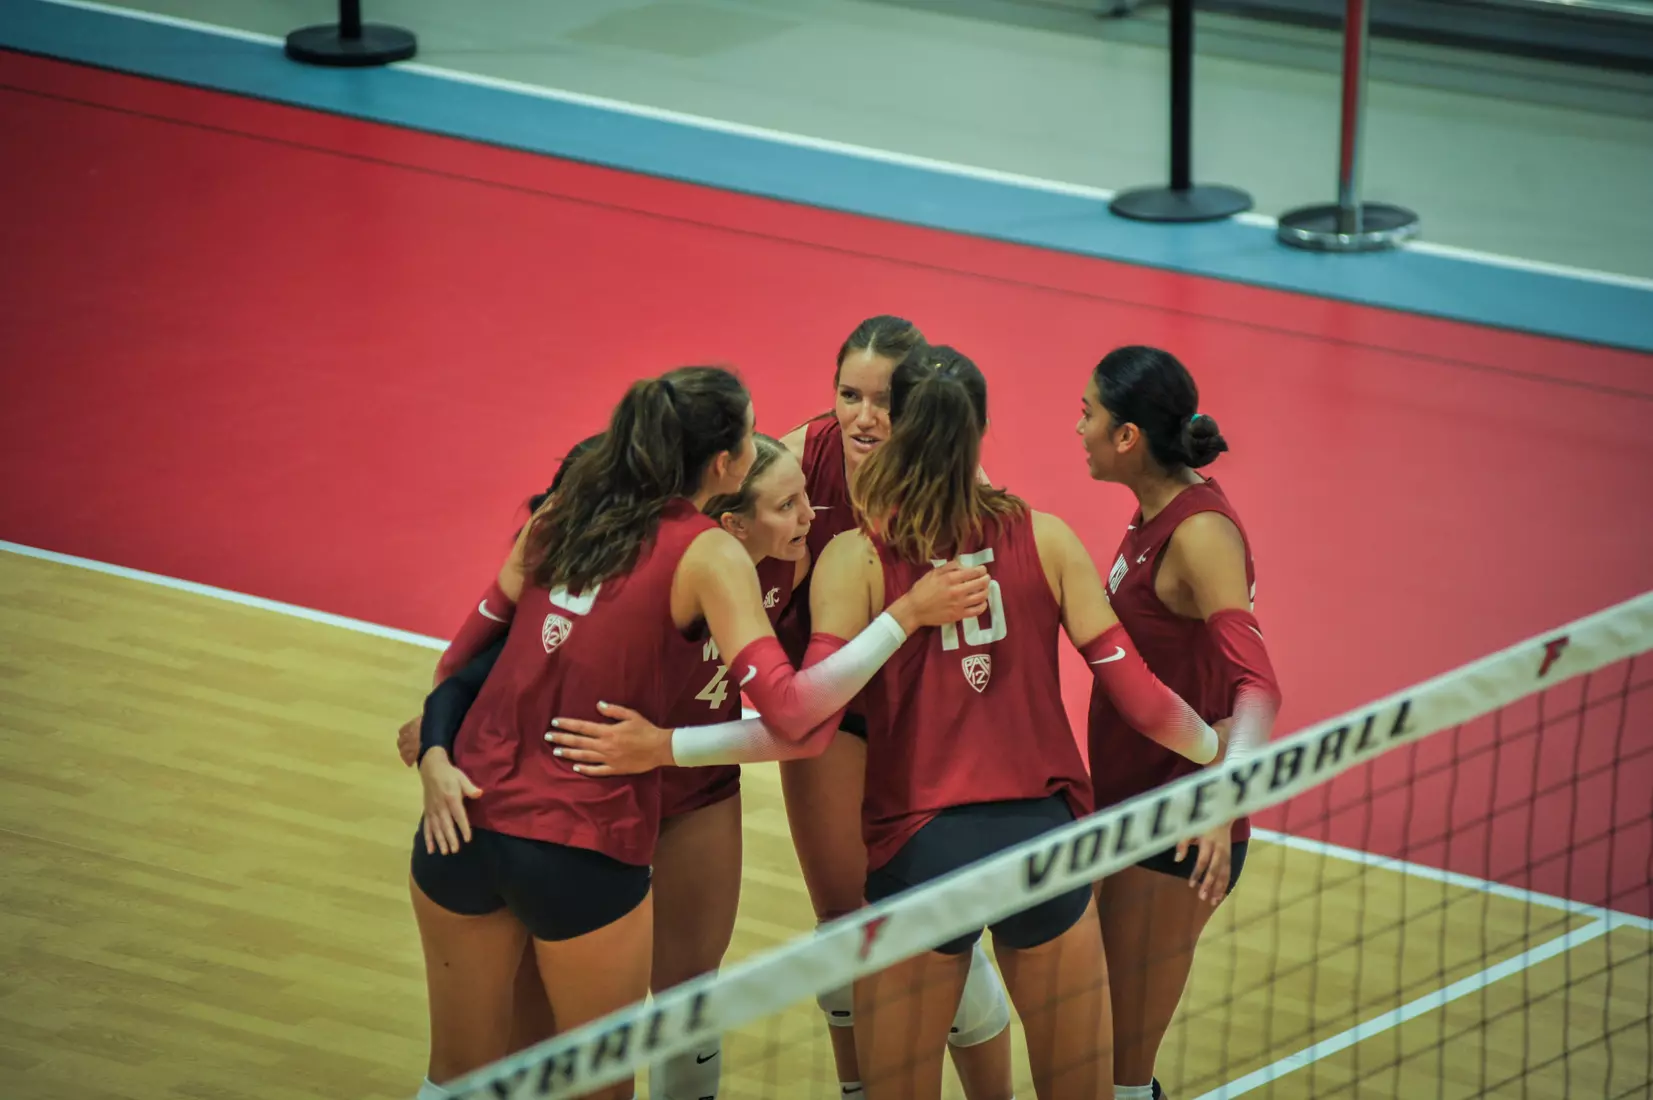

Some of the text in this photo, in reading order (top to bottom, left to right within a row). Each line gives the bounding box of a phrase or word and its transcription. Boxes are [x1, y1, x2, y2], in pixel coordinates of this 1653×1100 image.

[694, 665, 729, 710] 4
[962, 655, 990, 678] PAC
[971, 670, 986, 685] 12
[1024, 698, 1417, 889] VOLLEYBALL
[447, 990, 714, 1100] YBALL
